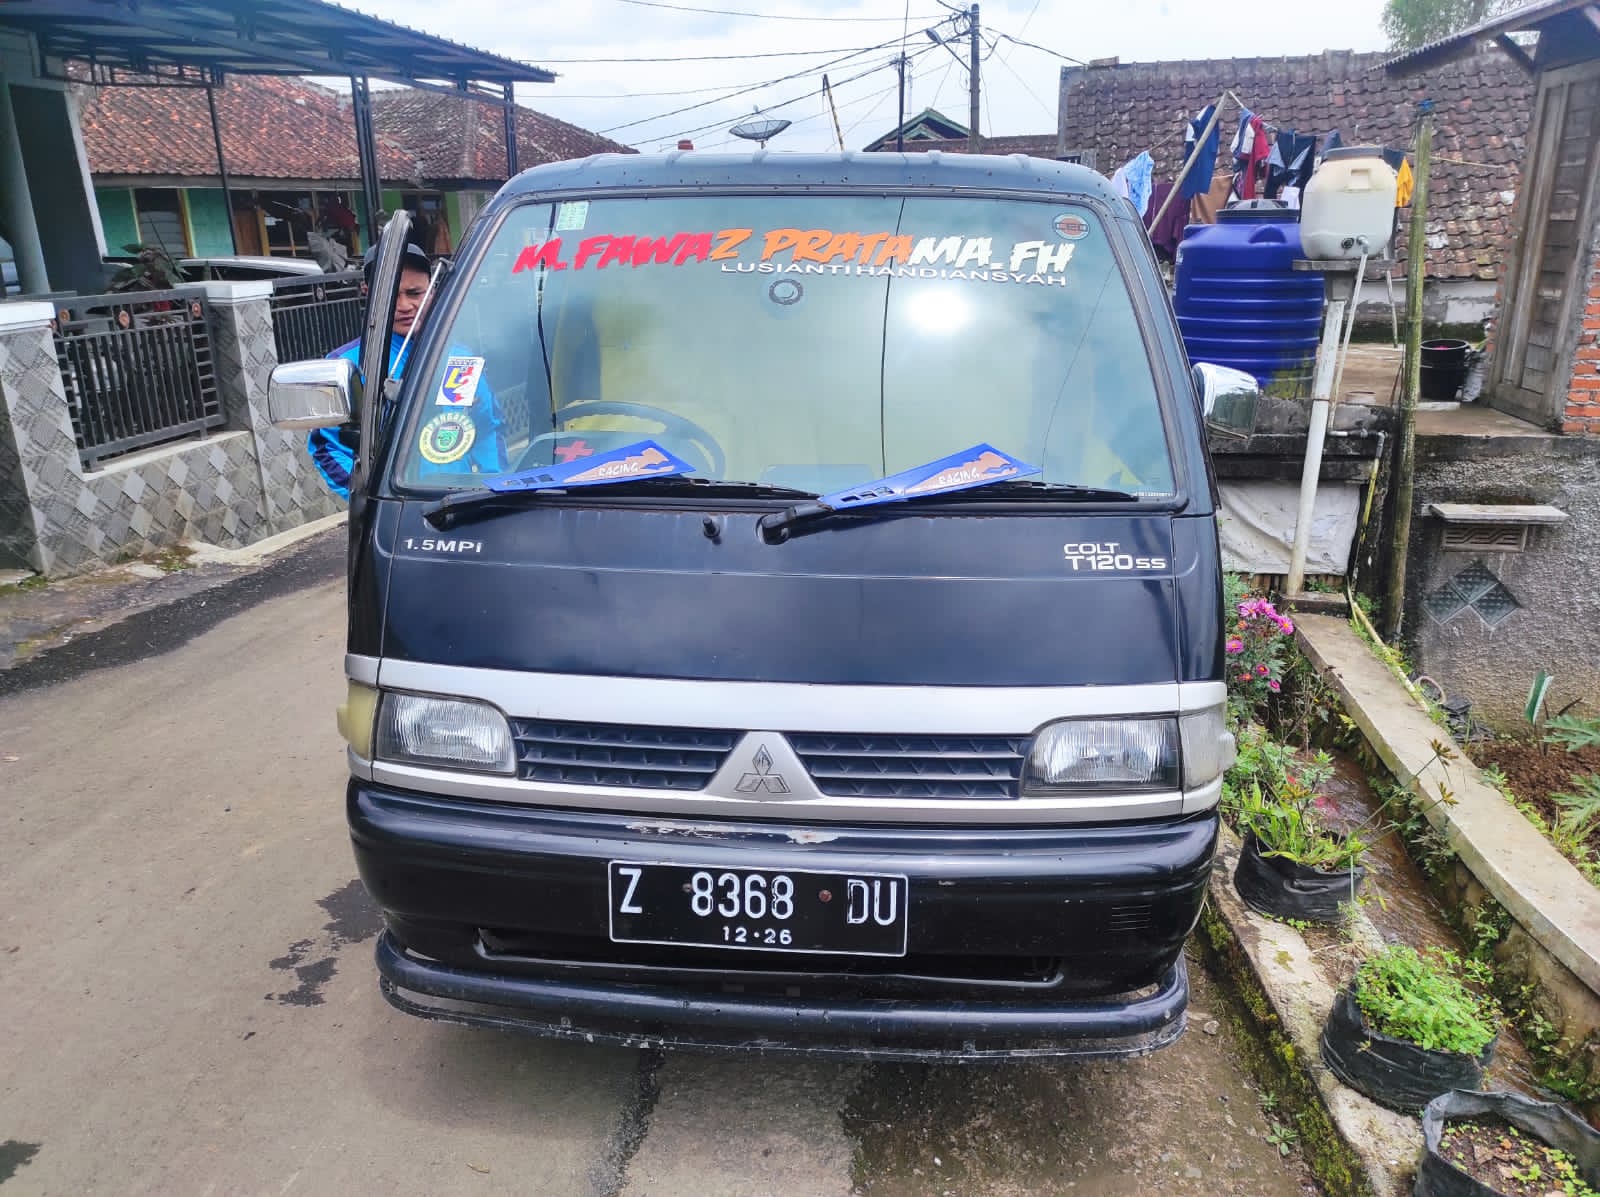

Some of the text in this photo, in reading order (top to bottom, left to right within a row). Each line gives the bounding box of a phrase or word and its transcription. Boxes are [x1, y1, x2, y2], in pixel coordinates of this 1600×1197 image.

[598, 462, 639, 477] RACING
[937, 467, 979, 485] RACING
[1063, 542, 1120, 555] COLT
[618, 867, 898, 926] Z 8368 DU
